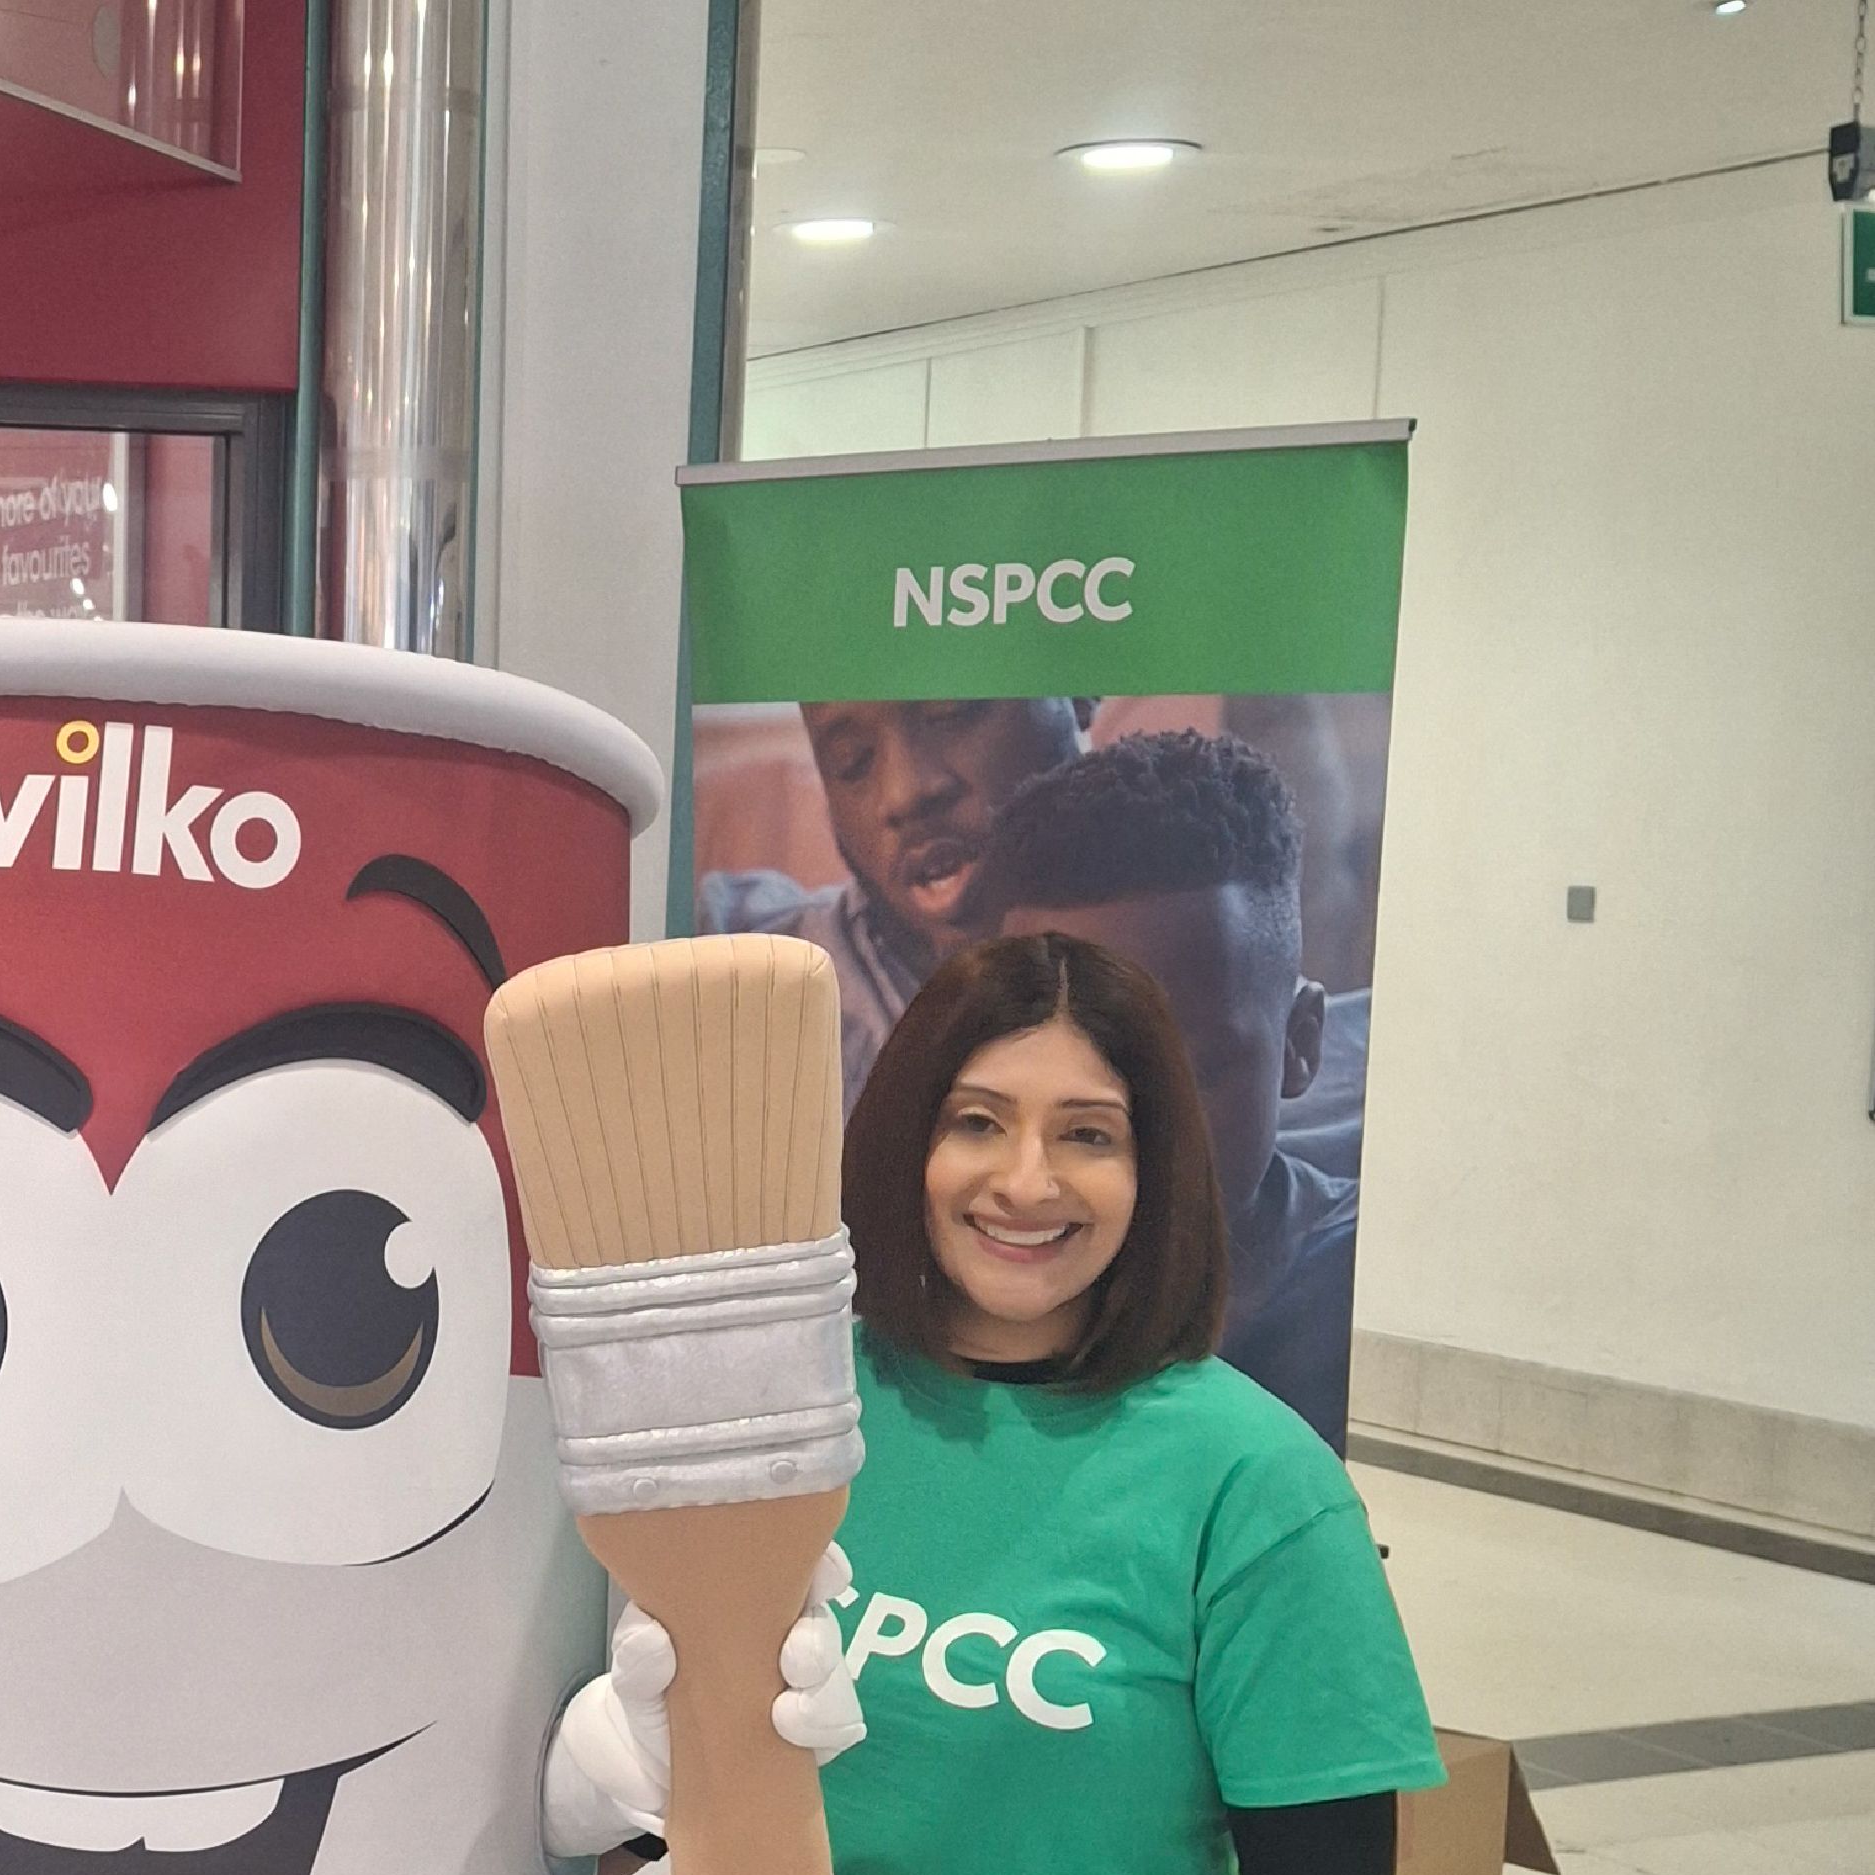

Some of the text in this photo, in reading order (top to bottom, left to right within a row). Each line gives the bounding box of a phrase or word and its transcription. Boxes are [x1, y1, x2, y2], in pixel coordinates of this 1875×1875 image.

[39, 474, 57, 520] of
[2, 534, 91, 586] favourites
[893, 556, 1136, 628] NSPCC
[834, 1585, 1107, 1730] PCC
